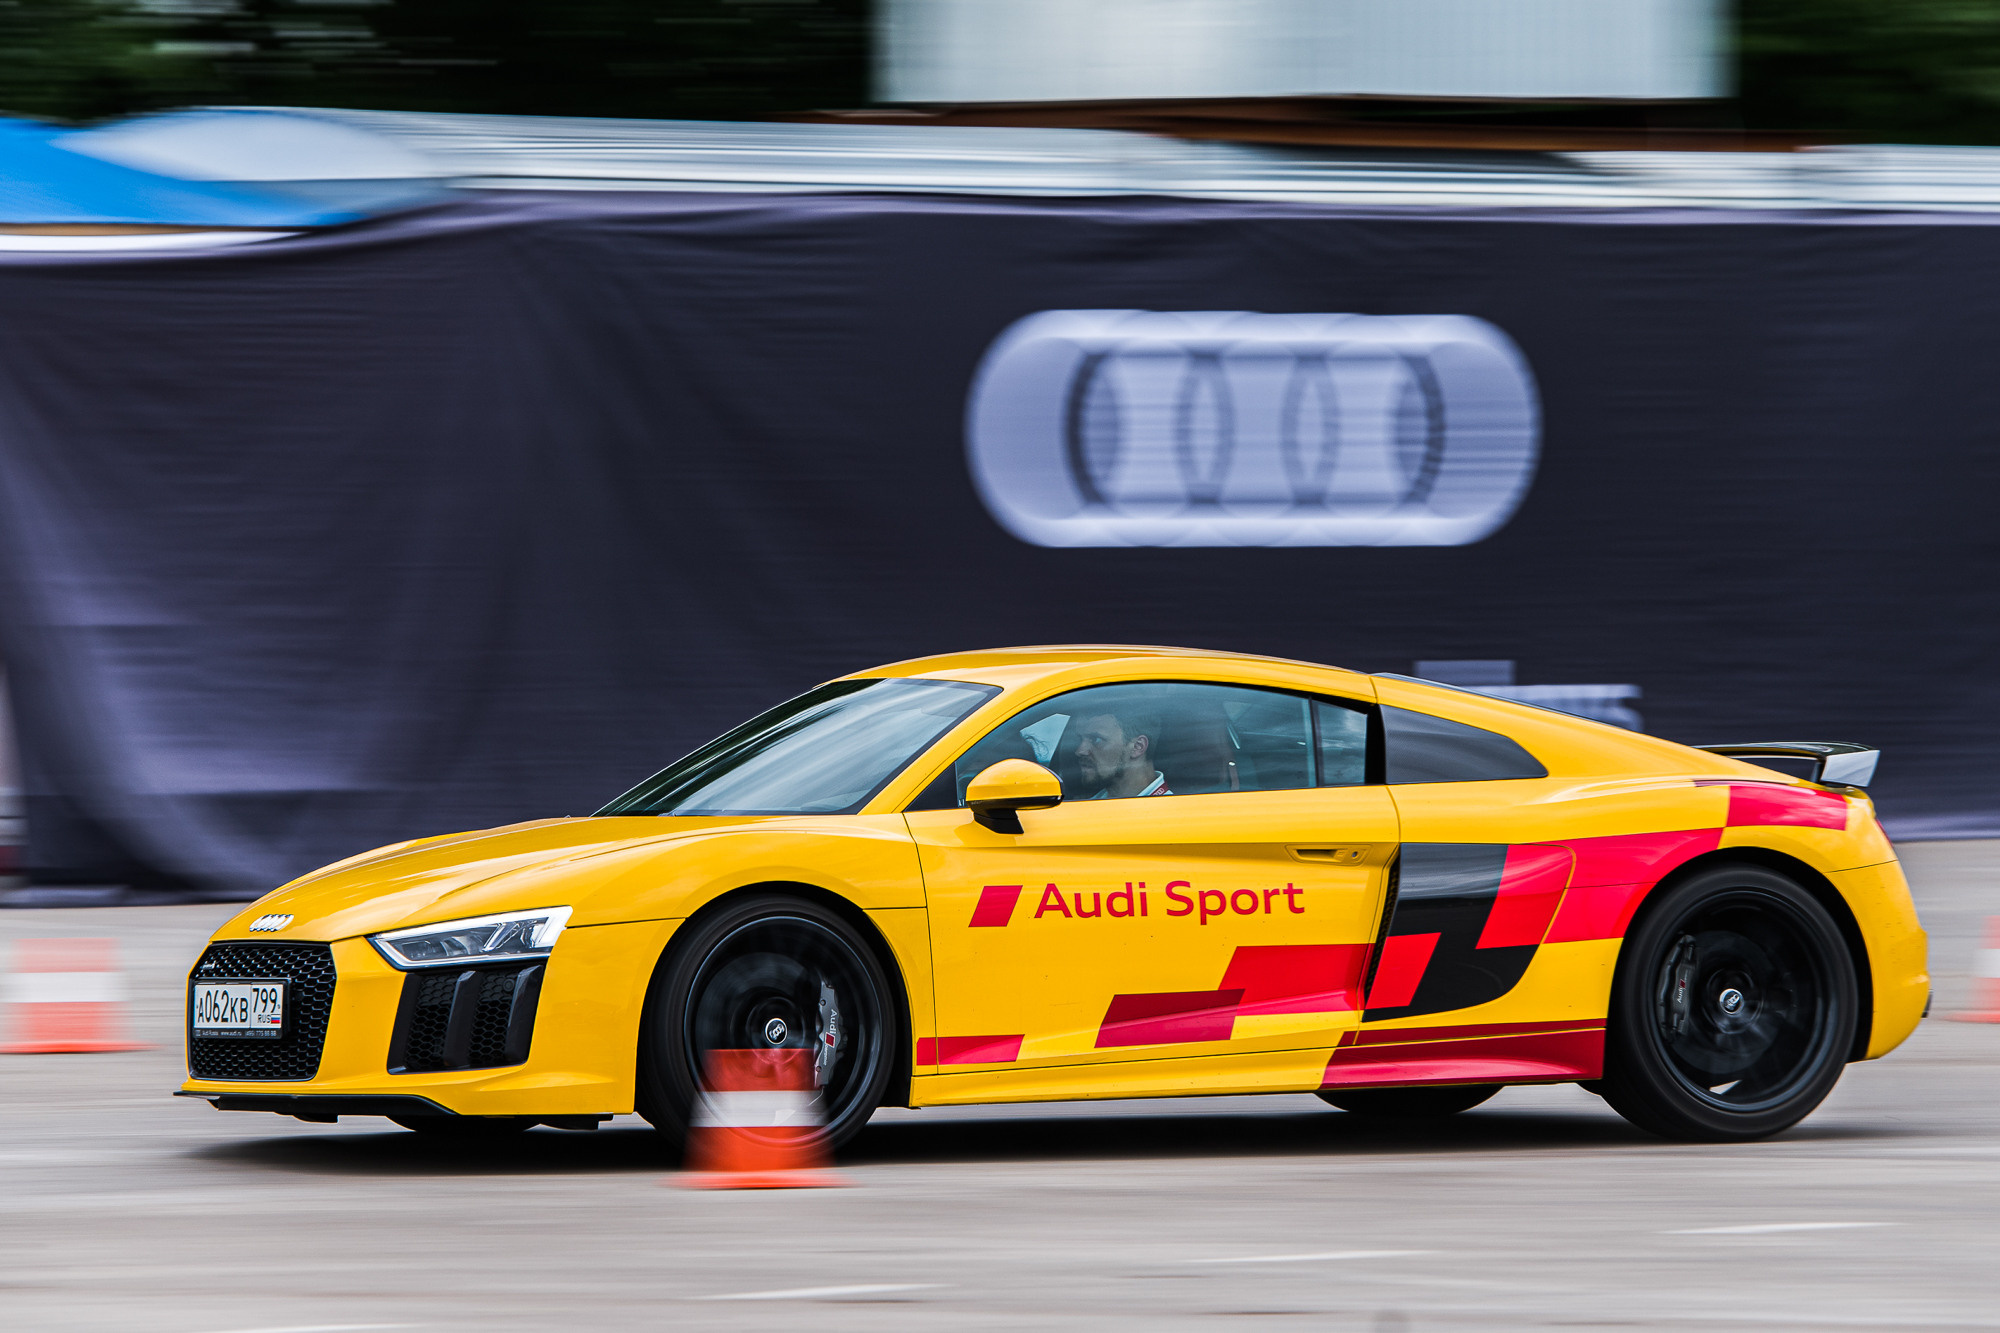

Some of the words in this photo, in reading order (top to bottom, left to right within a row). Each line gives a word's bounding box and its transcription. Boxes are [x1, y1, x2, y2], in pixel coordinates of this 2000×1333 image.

[1034, 881, 1148, 918] Audi
[1165, 880, 1306, 926] Sport
[198, 990, 249, 1022] A062KB
[252, 987, 278, 1013] 799
[257, 1014, 271, 1023] RUS
[830, 1009, 838, 1034] Audi
